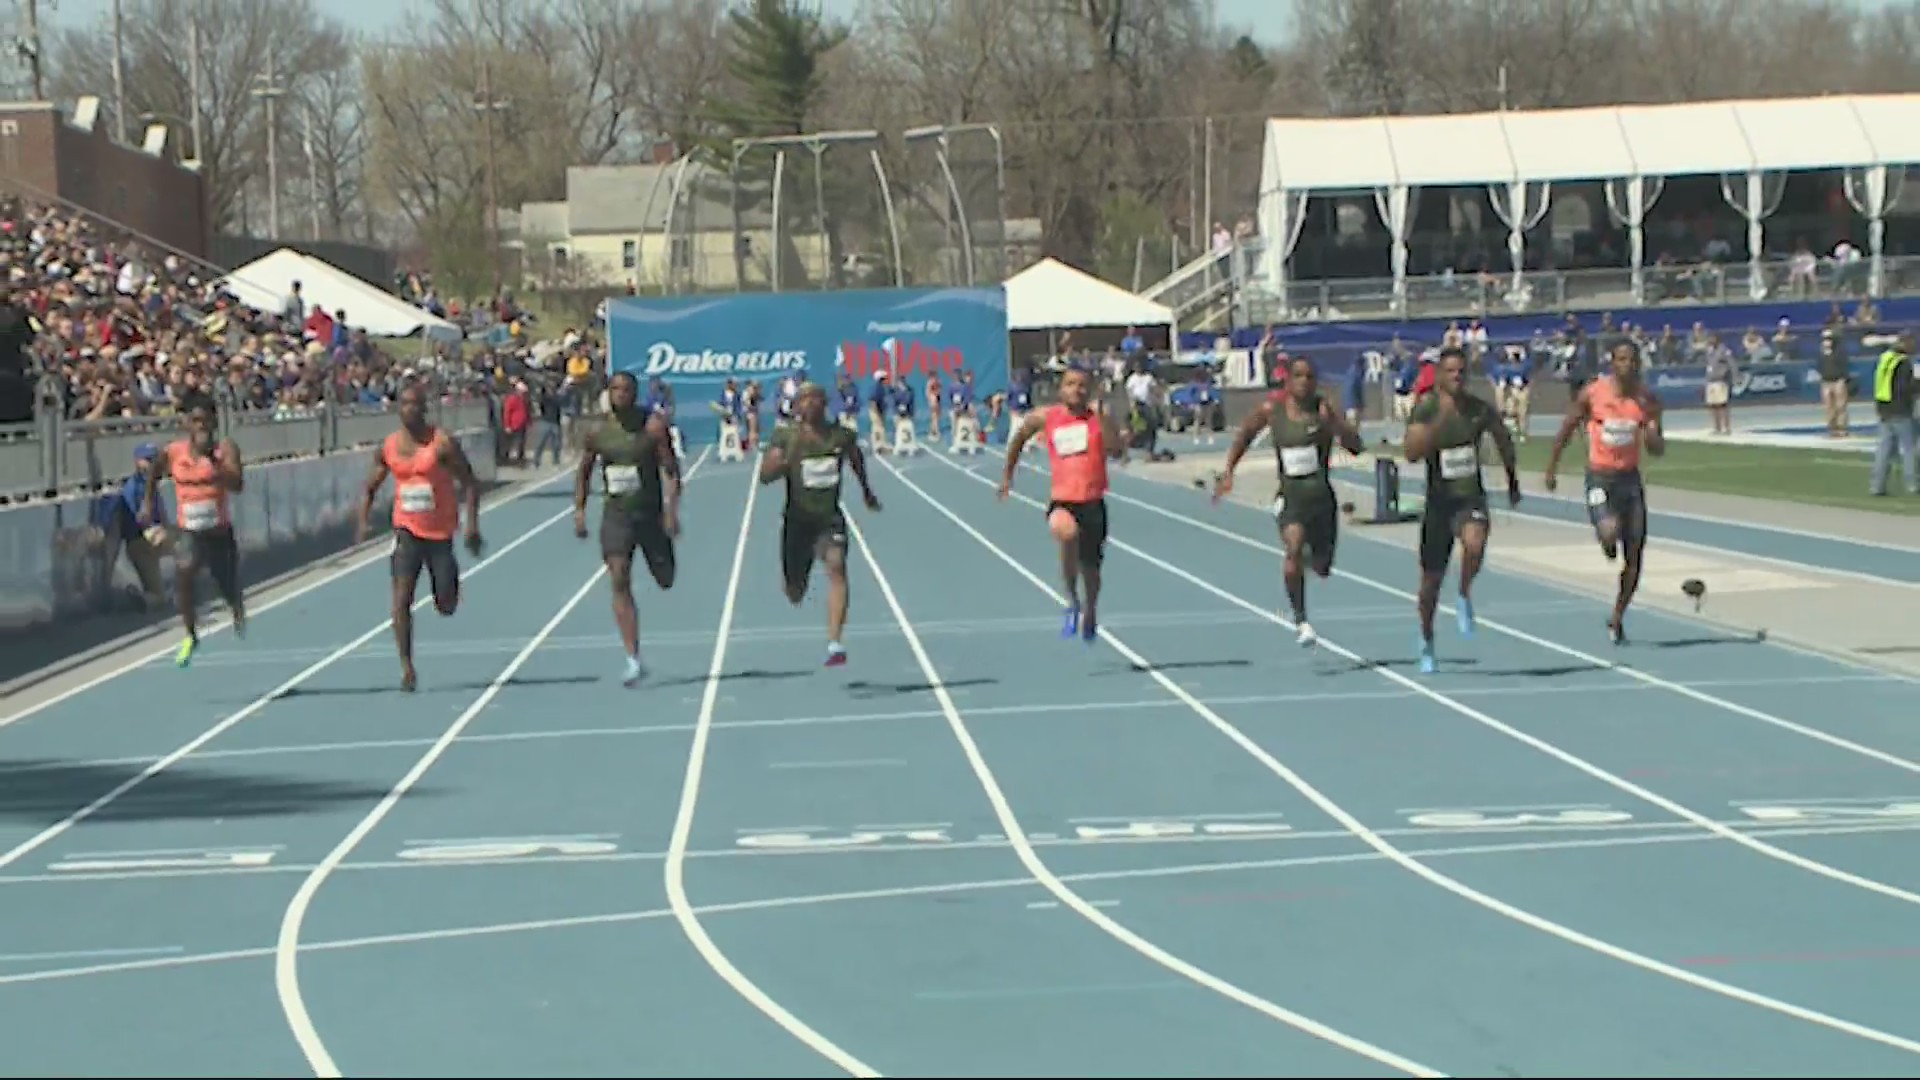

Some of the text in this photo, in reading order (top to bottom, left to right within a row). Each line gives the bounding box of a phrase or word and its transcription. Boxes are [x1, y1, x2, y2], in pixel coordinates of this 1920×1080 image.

[867, 320, 942, 333] Presented by
[645, 341, 808, 376] Drake RELAYS
[960, 427, 970, 442] 2
